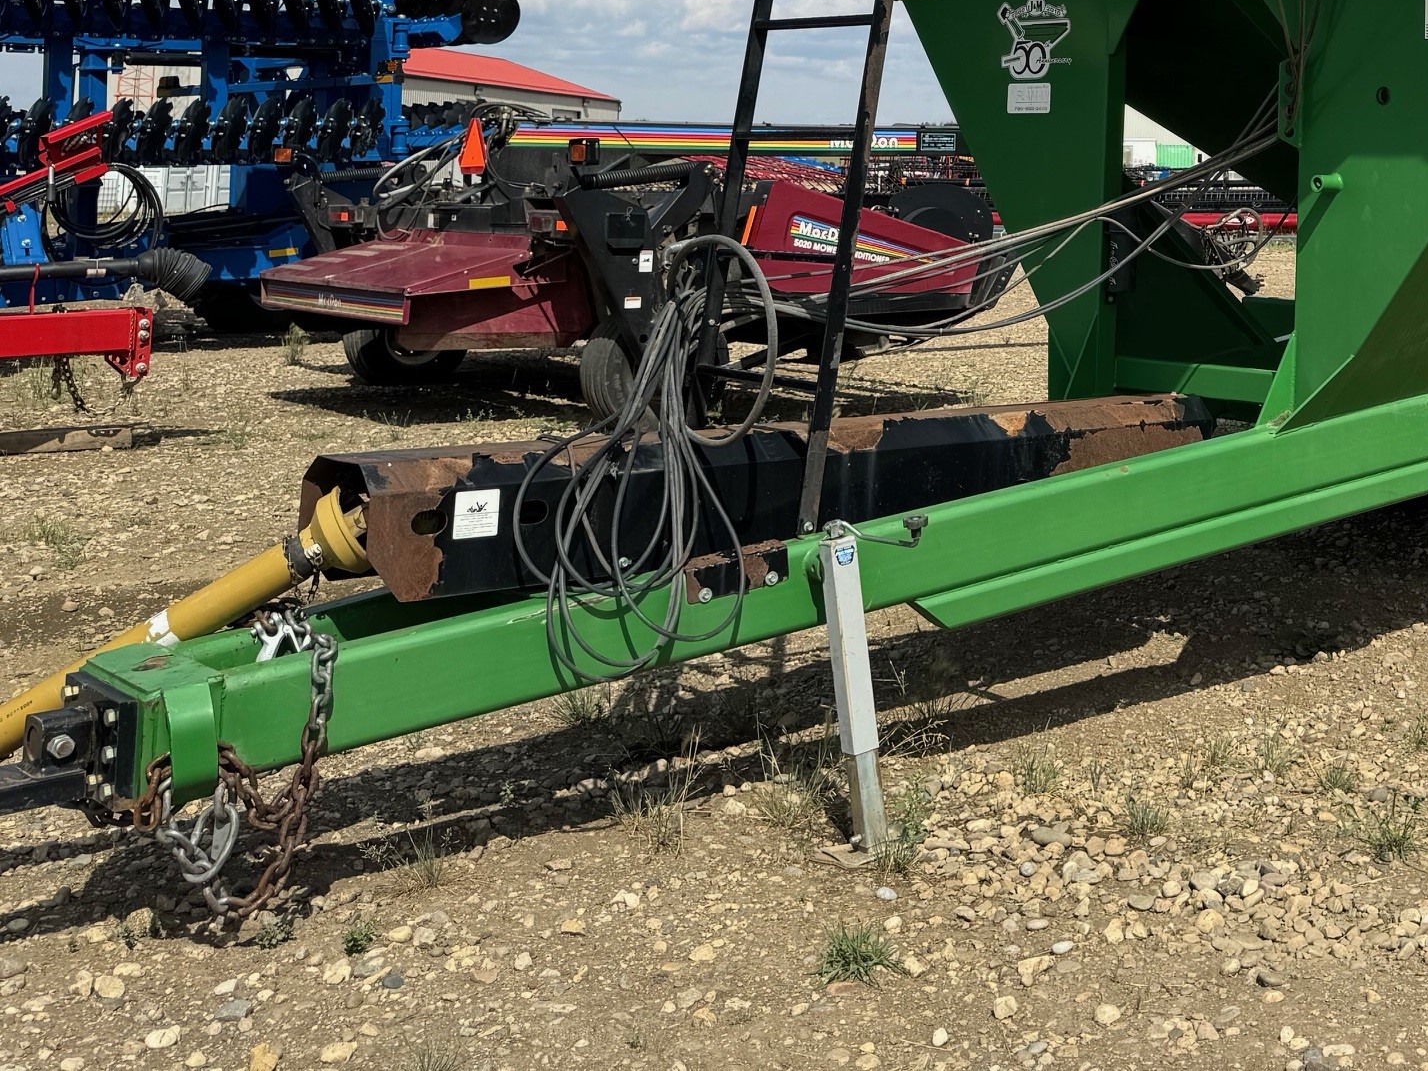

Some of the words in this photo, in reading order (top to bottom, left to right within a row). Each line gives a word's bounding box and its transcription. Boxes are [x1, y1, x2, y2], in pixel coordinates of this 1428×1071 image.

[1012, 41, 1047, 75] 50
[793, 238, 812, 249] 5020
[813, 242, 838, 254] MOWE
